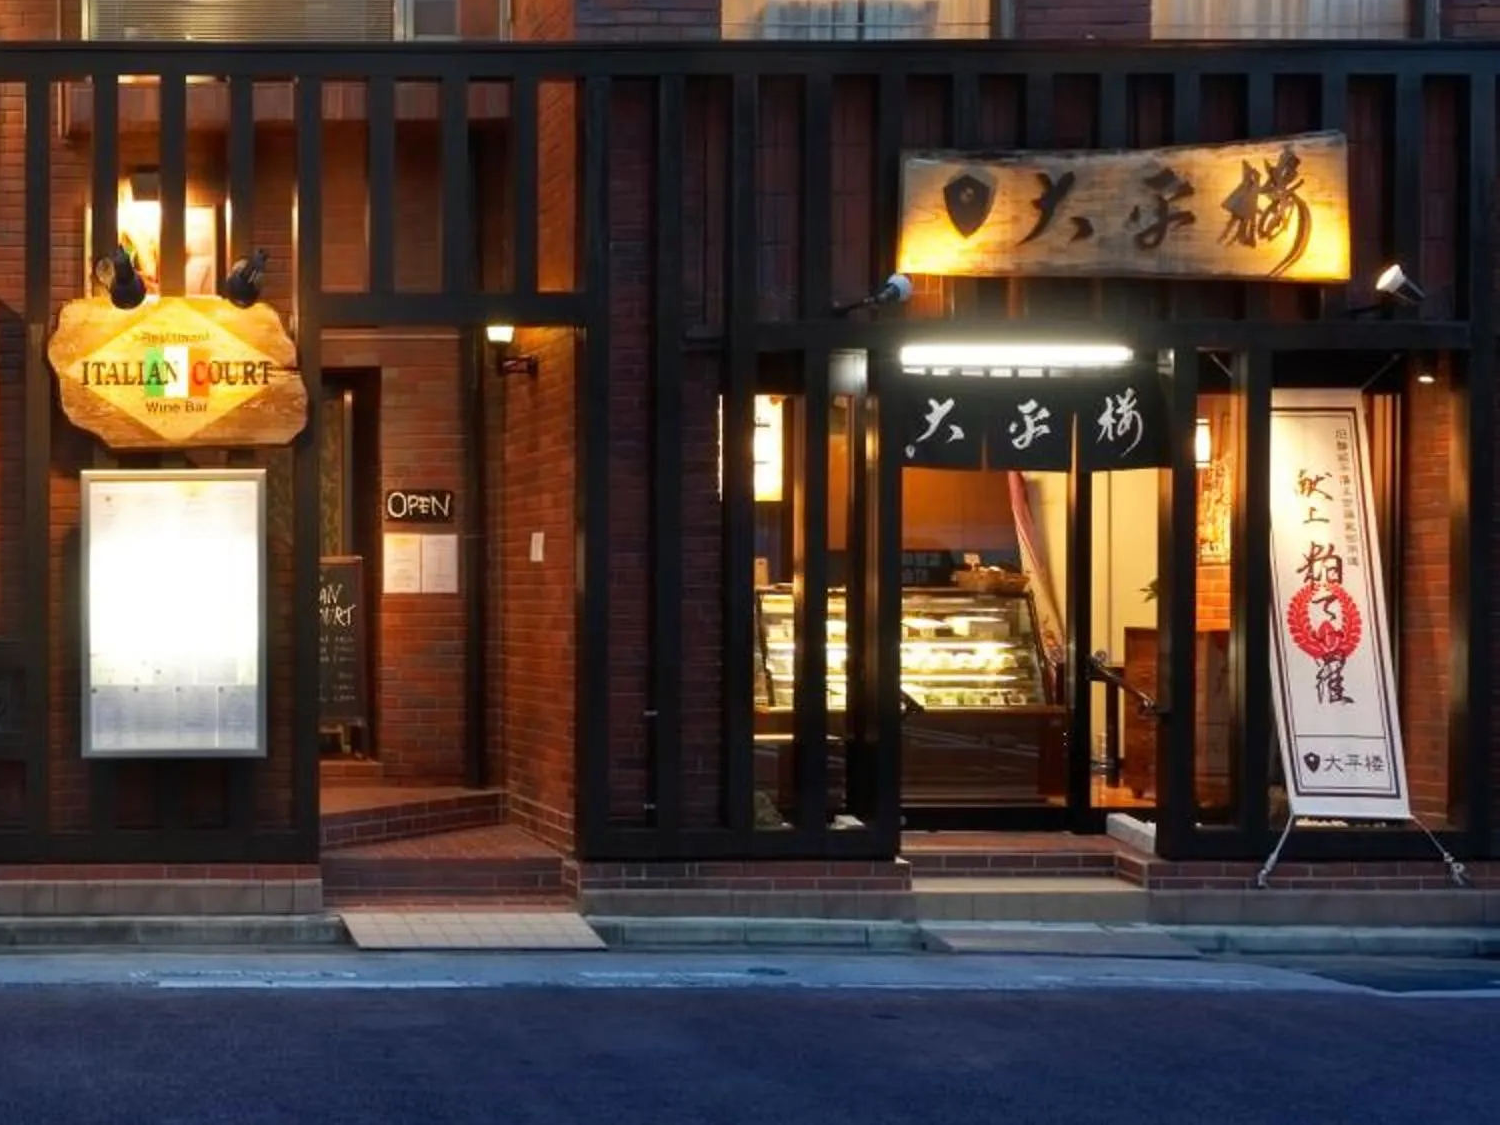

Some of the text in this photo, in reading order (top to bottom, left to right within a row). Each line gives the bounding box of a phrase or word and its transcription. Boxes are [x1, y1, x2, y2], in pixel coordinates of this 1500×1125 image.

[80, 360, 272, 387] ITALIAN COURT
[145, 401, 209, 414] Wine Bar
[387, 491, 451, 518] OPEN
